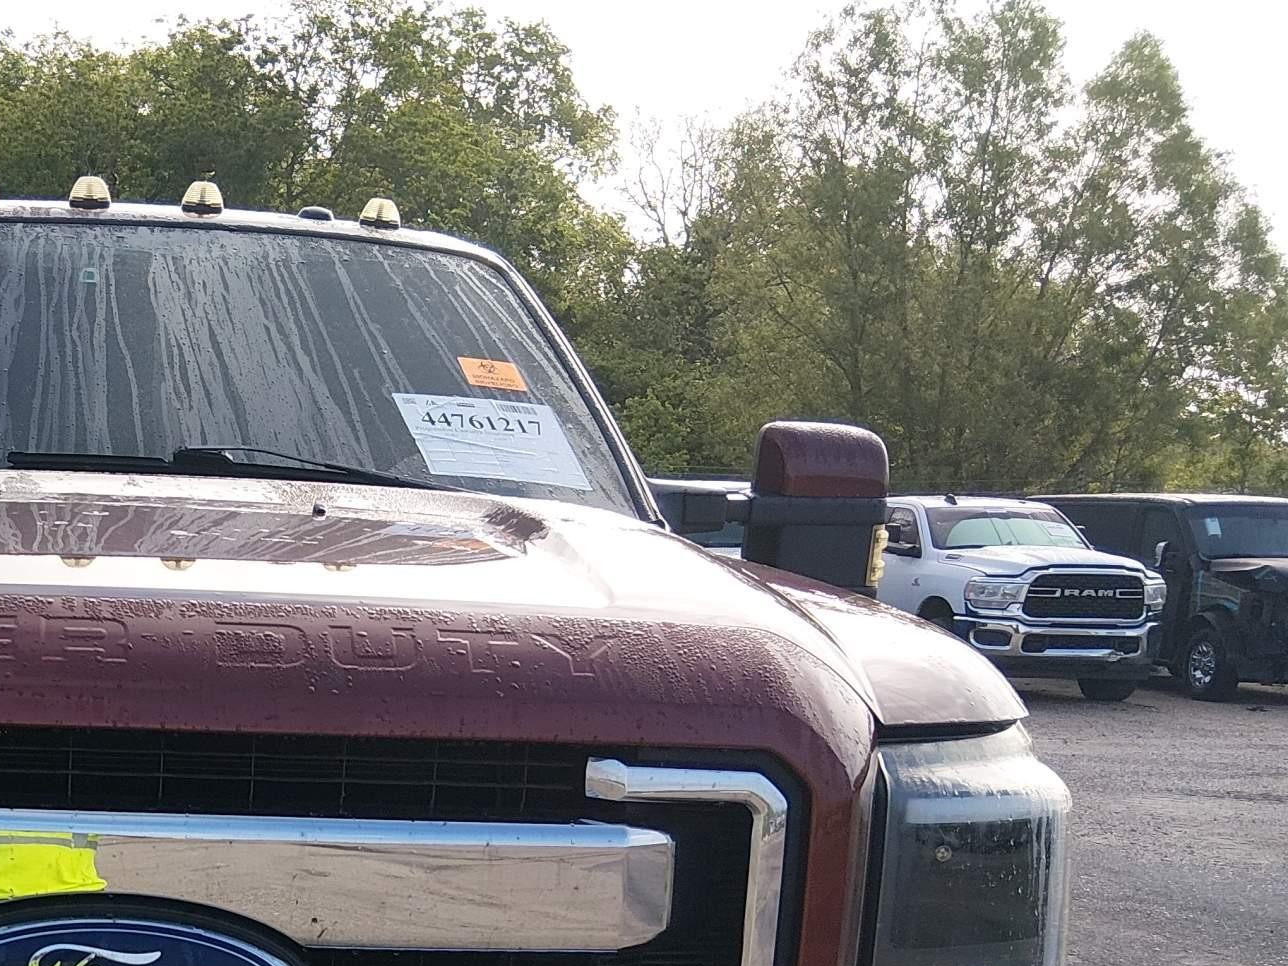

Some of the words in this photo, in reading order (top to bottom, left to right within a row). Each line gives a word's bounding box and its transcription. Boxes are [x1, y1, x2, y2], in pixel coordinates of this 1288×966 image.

[421, 411, 542, 436] 44761217
[1063, 588, 1114, 597] RAM
[213, 620, 623, 677] DUTY
